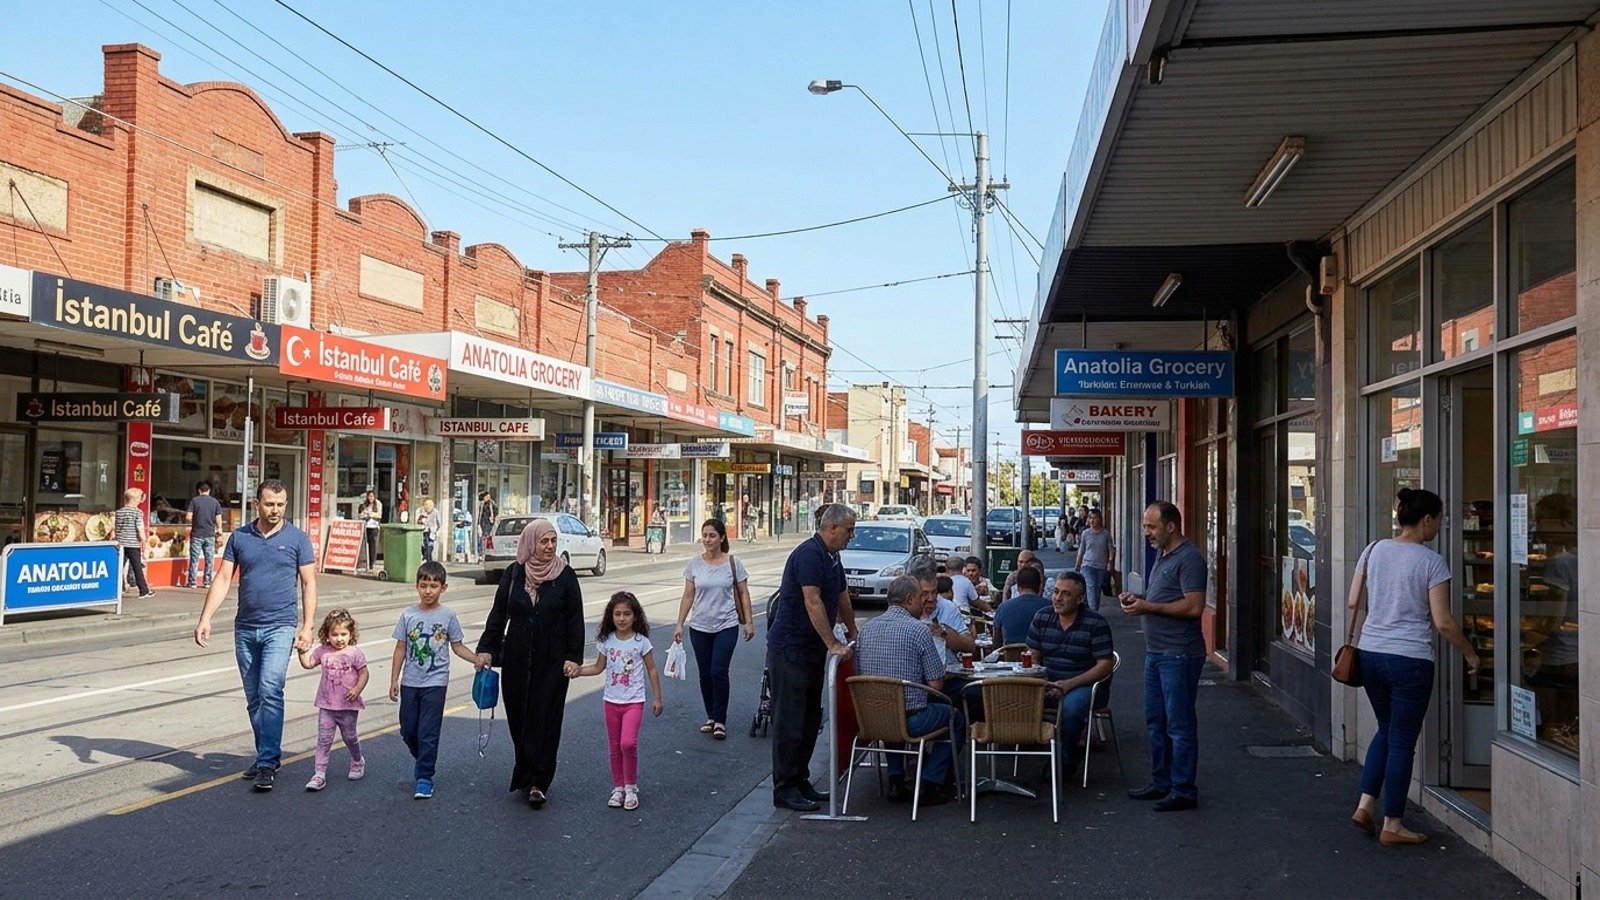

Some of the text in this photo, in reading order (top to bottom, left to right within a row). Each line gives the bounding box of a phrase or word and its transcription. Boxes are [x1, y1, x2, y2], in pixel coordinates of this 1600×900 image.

[55, 278, 234, 352] İstanbul Café
[319, 333, 385, 377] İstanbul
[389, 355, 422, 383] Café
[461, 342, 582, 391] ANATOLIA GROCERY
[1063, 357, 1226, 379] Anatolia Grocery
[51, 399, 162, 417] Istanbul Café
[283, 411, 339, 426] Istanbul
[343, 412, 376, 426] Cafe
[1089, 405, 1158, 417] BAKERY
[440, 421, 496, 433] ISTANBUL
[17, 560, 109, 584] ANATOLIA
